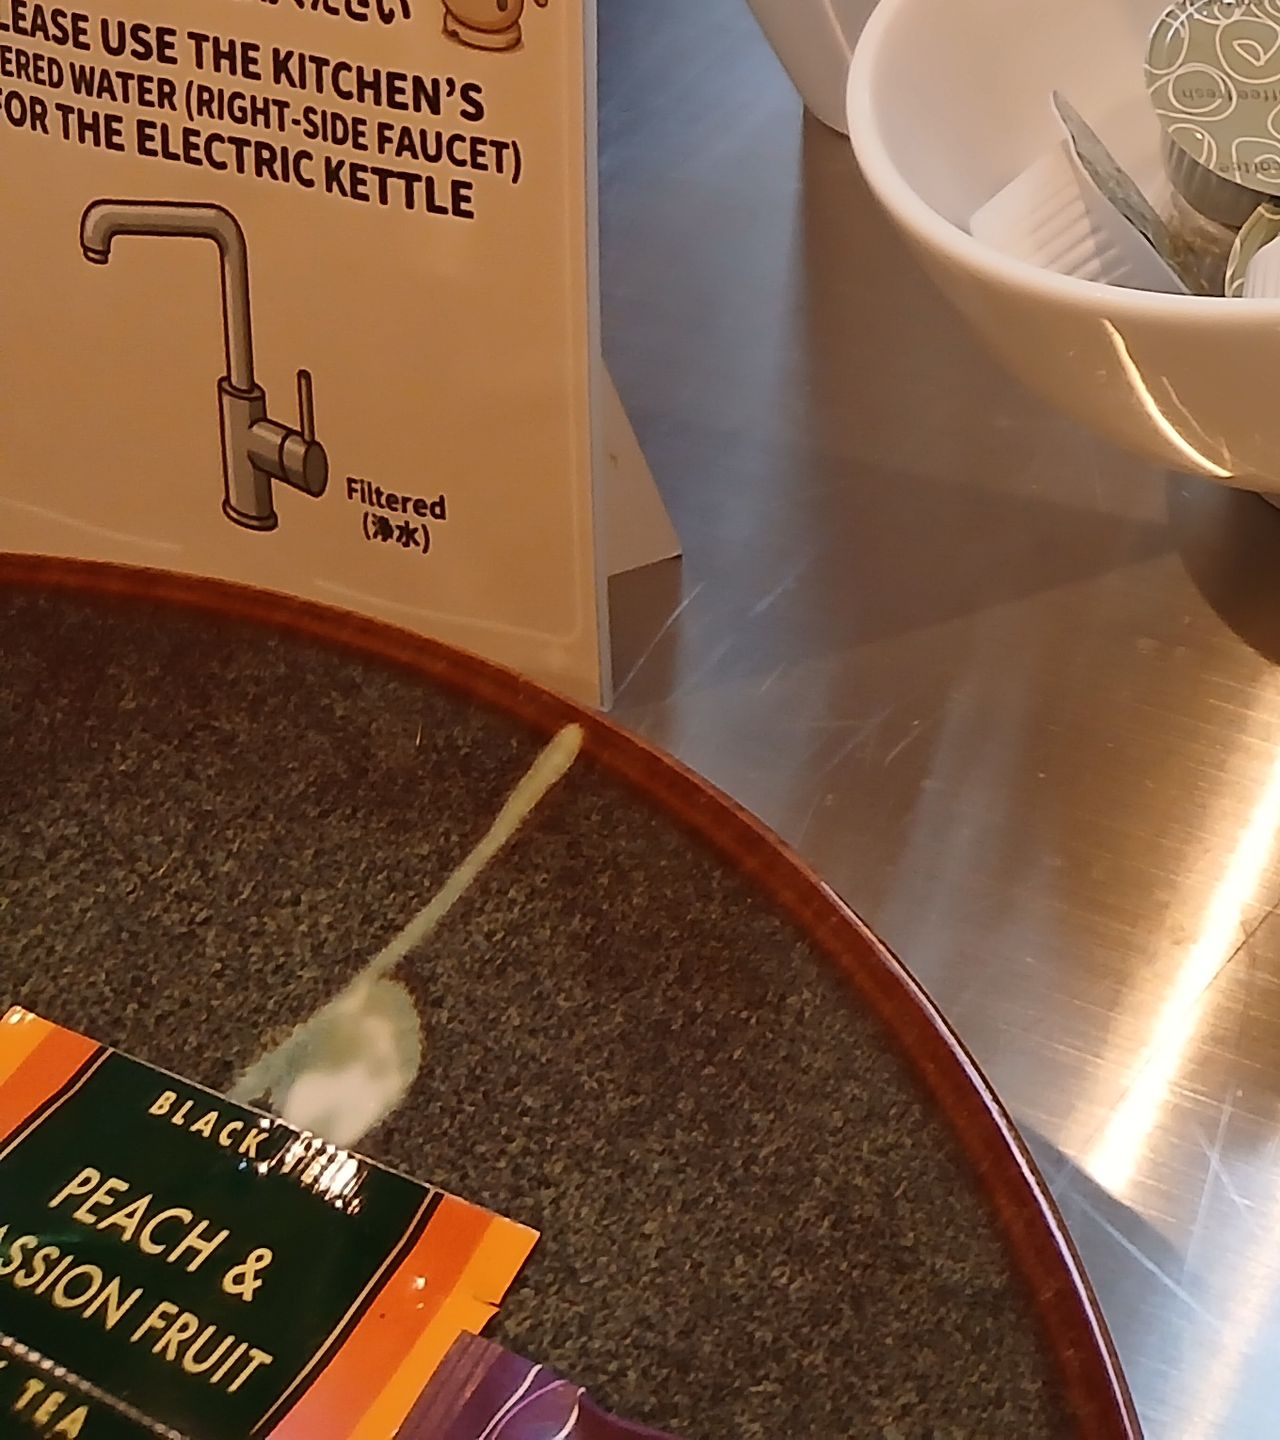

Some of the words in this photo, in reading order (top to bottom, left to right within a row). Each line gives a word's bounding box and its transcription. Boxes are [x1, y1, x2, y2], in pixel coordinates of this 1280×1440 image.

[101, 18, 178, 65] USE
[187, 32, 261, 80] THE
[272, 47, 485, 122] KITCHEN’S
[0, 88, 49, 135] OR
[55, 103, 125, 152] THE
[136, 119, 315, 188] ELECTRIC
[325, 156, 475, 219] KETTLE
[70, 62, 177, 111] WATER
[185, 80, 368, 152] (RIGHT-SIDE
[377, 122, 521, 184] FAUCET)
[346, 477, 446, 520] Filtered
[148, 1090, 269, 1158] BLACK
[47, 1166, 230, 1272] PEACH
[222, 1248, 273, 1302] &
[130, 1301, 273, 1392] FRUIT
[14, 1378, 89, 1439] TEA
